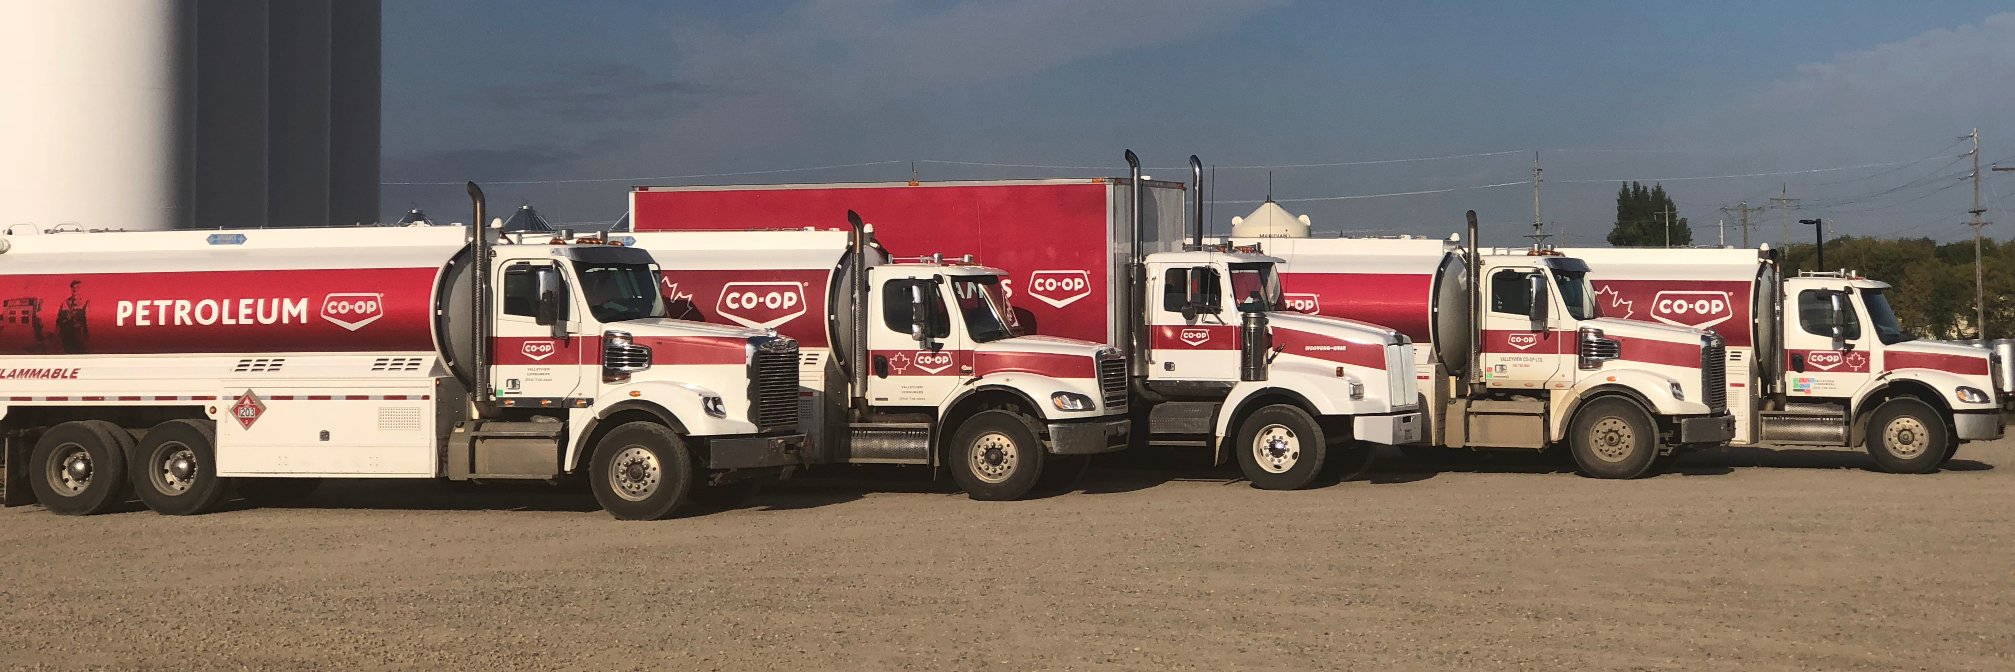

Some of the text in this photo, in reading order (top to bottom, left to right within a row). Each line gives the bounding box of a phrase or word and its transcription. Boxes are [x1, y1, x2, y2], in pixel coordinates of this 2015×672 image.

[1034, 278, 1084, 291] CO-OP
[326, 300, 377, 315] CO-OP
[726, 291, 798, 310] CO-OP
[1659, 299, 1724, 315] CO-OP
[116, 297, 308, 327] PETROLEUM
[917, 356, 949, 364] CO-OP
[1811, 354, 1840, 363] CO-OP
